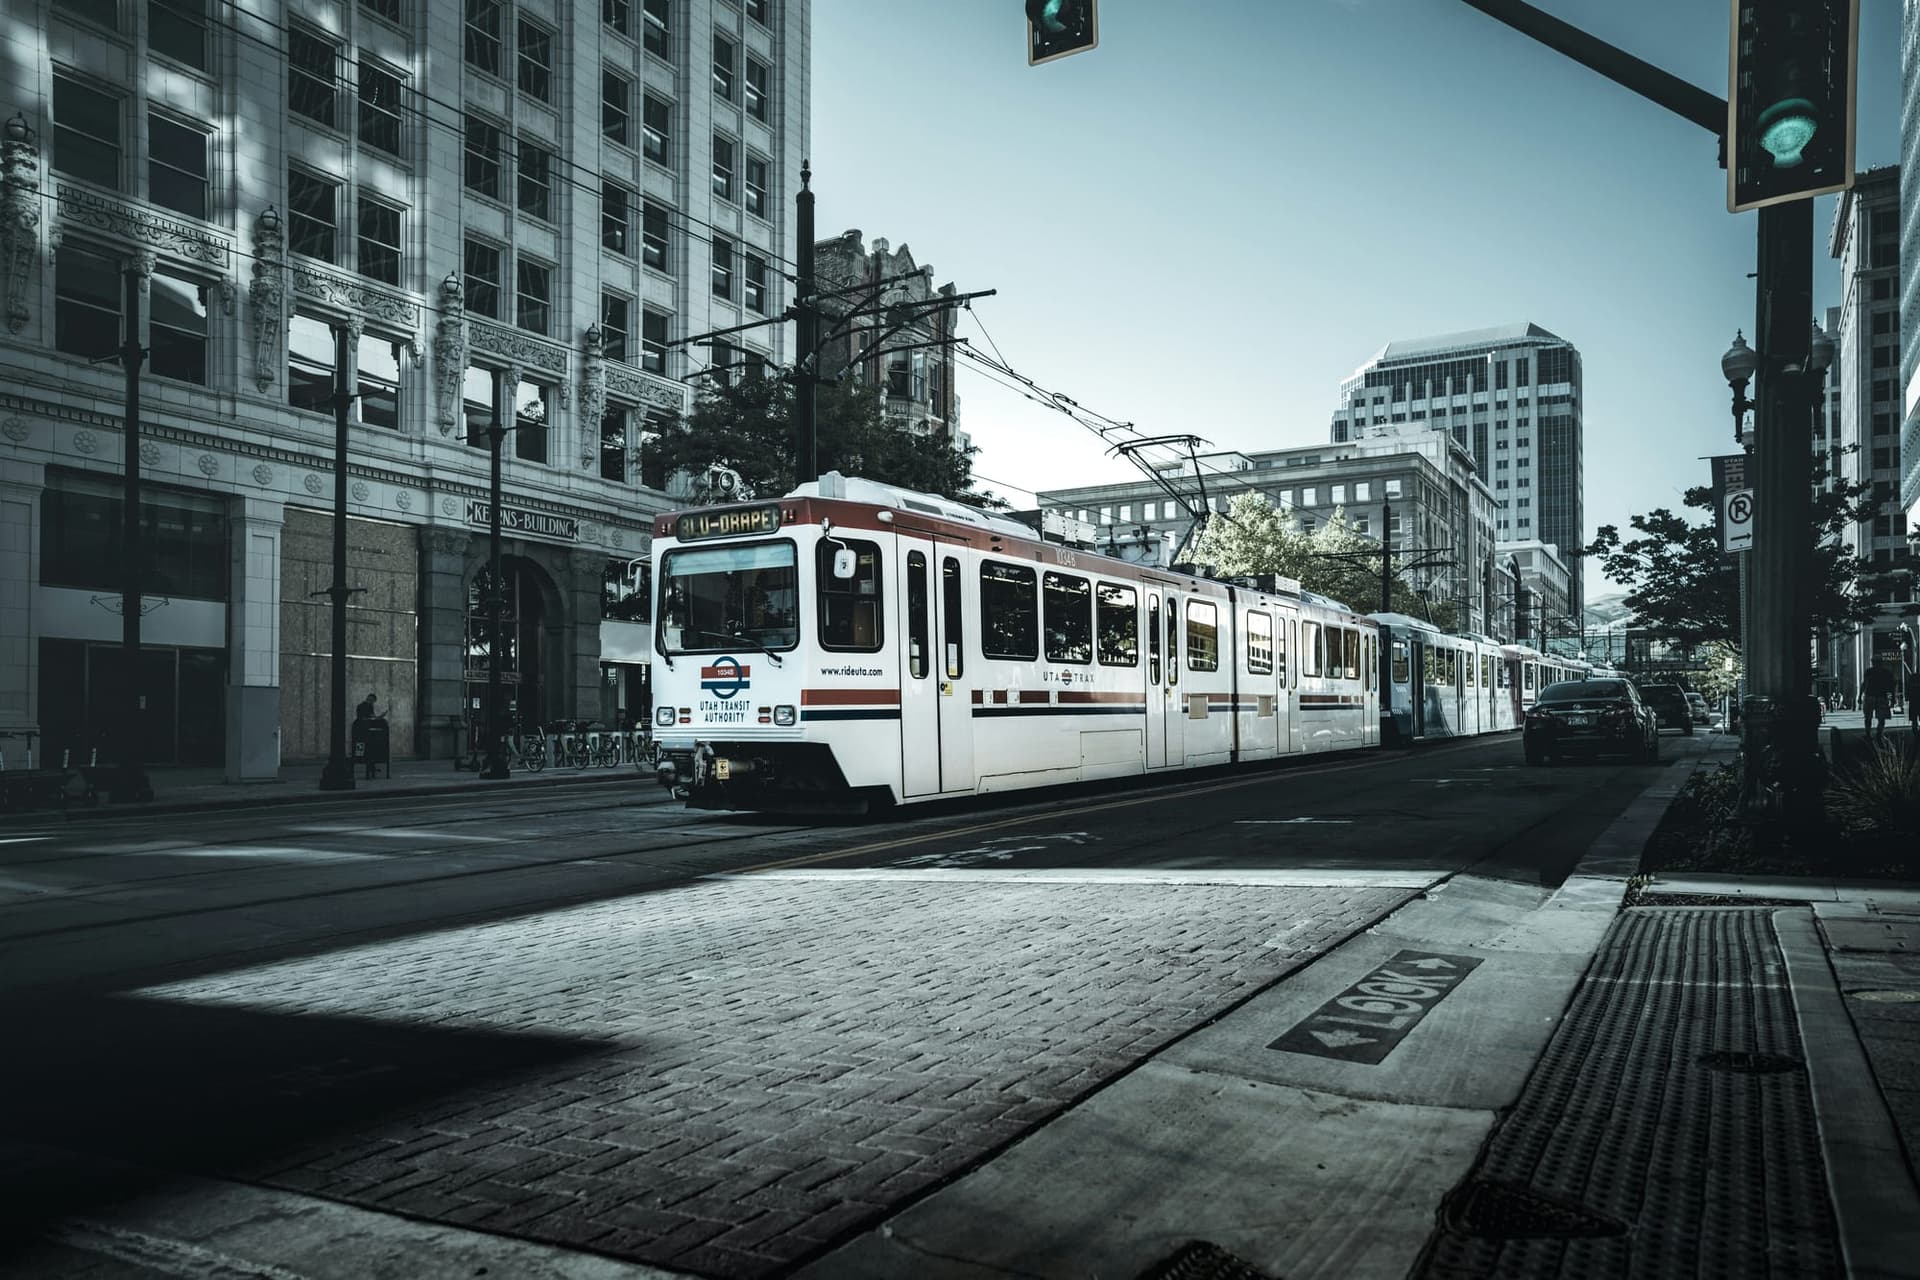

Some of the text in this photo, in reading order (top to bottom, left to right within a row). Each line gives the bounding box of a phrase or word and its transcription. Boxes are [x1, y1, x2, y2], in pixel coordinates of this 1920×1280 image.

[820, 665, 883, 677] www.rideuta.com
[1043, 671, 1095, 683] UTA TRAX
[699, 700, 750, 711] UTAH TRANSIT
[704, 712, 745, 723] AUTHORITY
